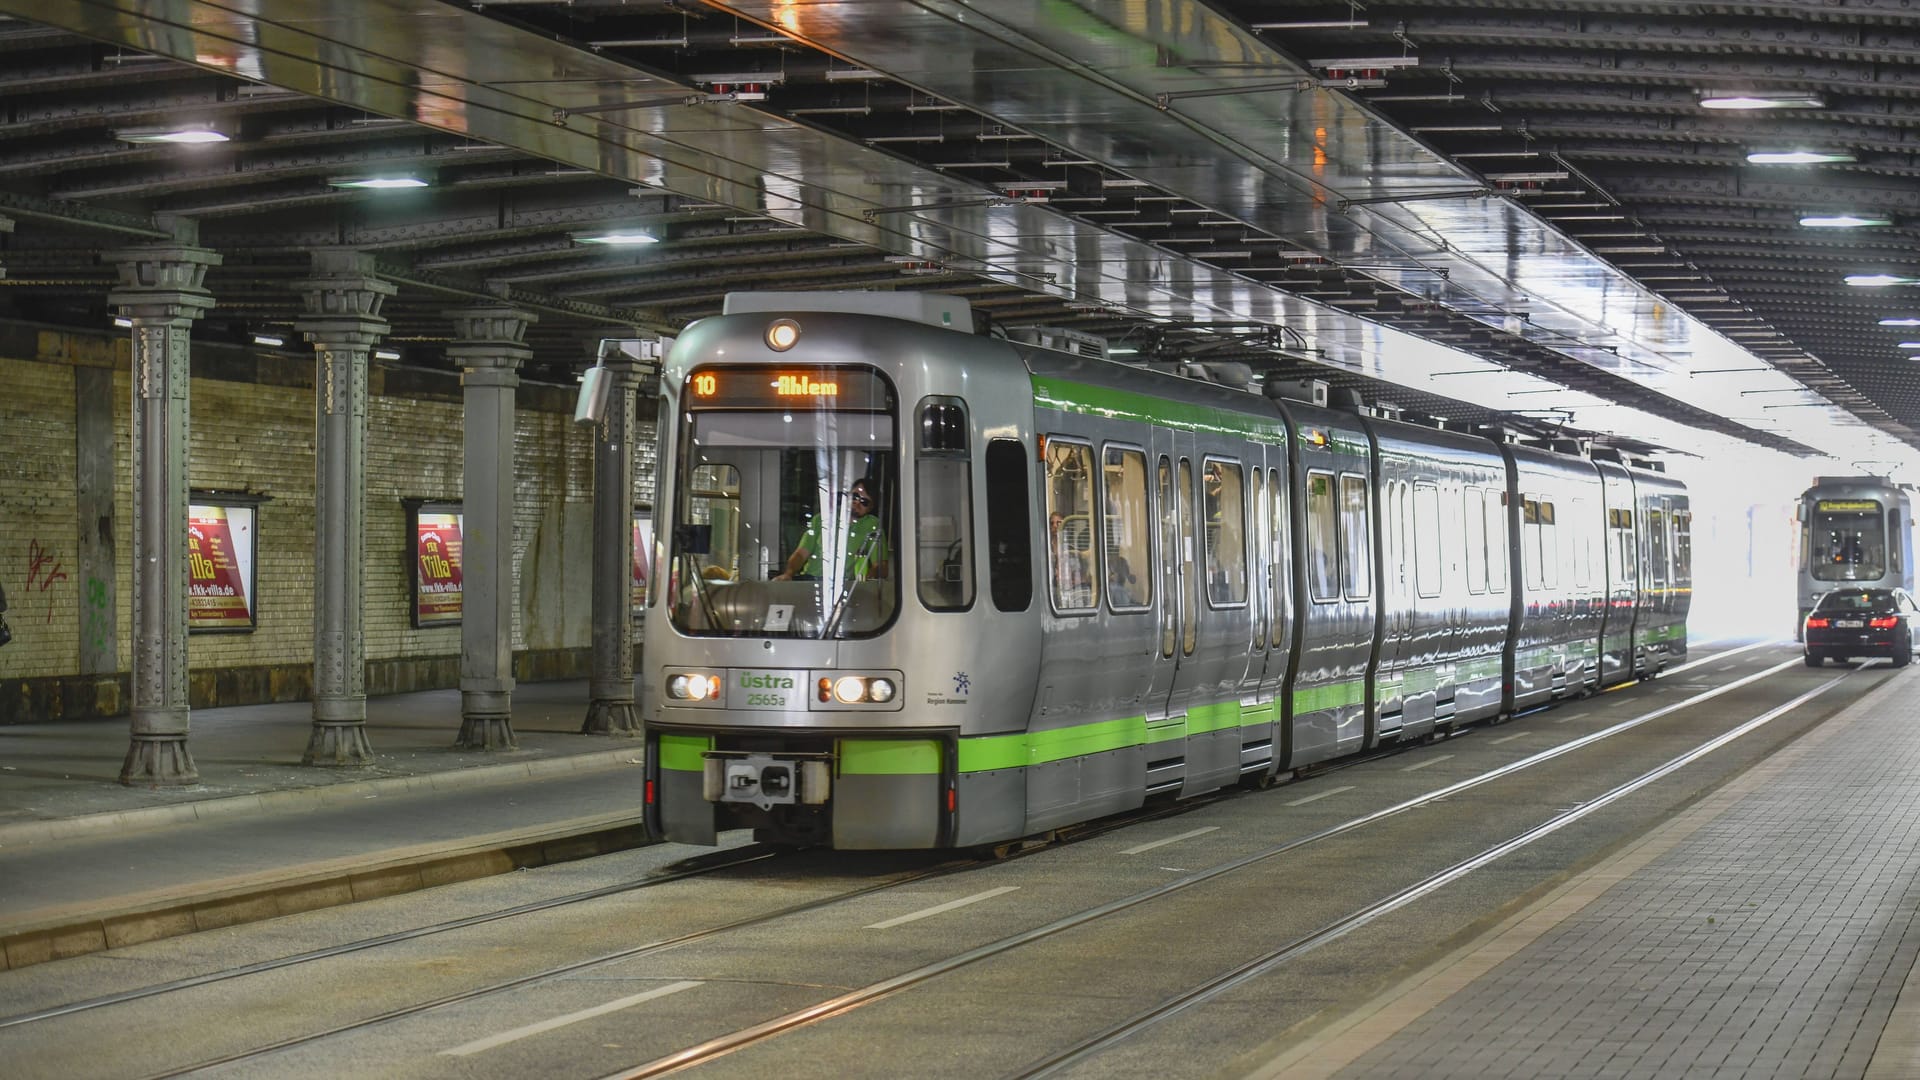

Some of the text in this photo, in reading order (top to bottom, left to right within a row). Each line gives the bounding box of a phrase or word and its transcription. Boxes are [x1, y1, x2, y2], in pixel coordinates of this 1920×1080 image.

[695, 376, 837, 395] 10 Ahlem
[189, 553, 216, 579] illa
[421, 554, 451, 578] Villa
[775, 609, 784, 619] 1
[740, 672, 794, 689] üstra
[747, 694, 785, 706] 2565a
